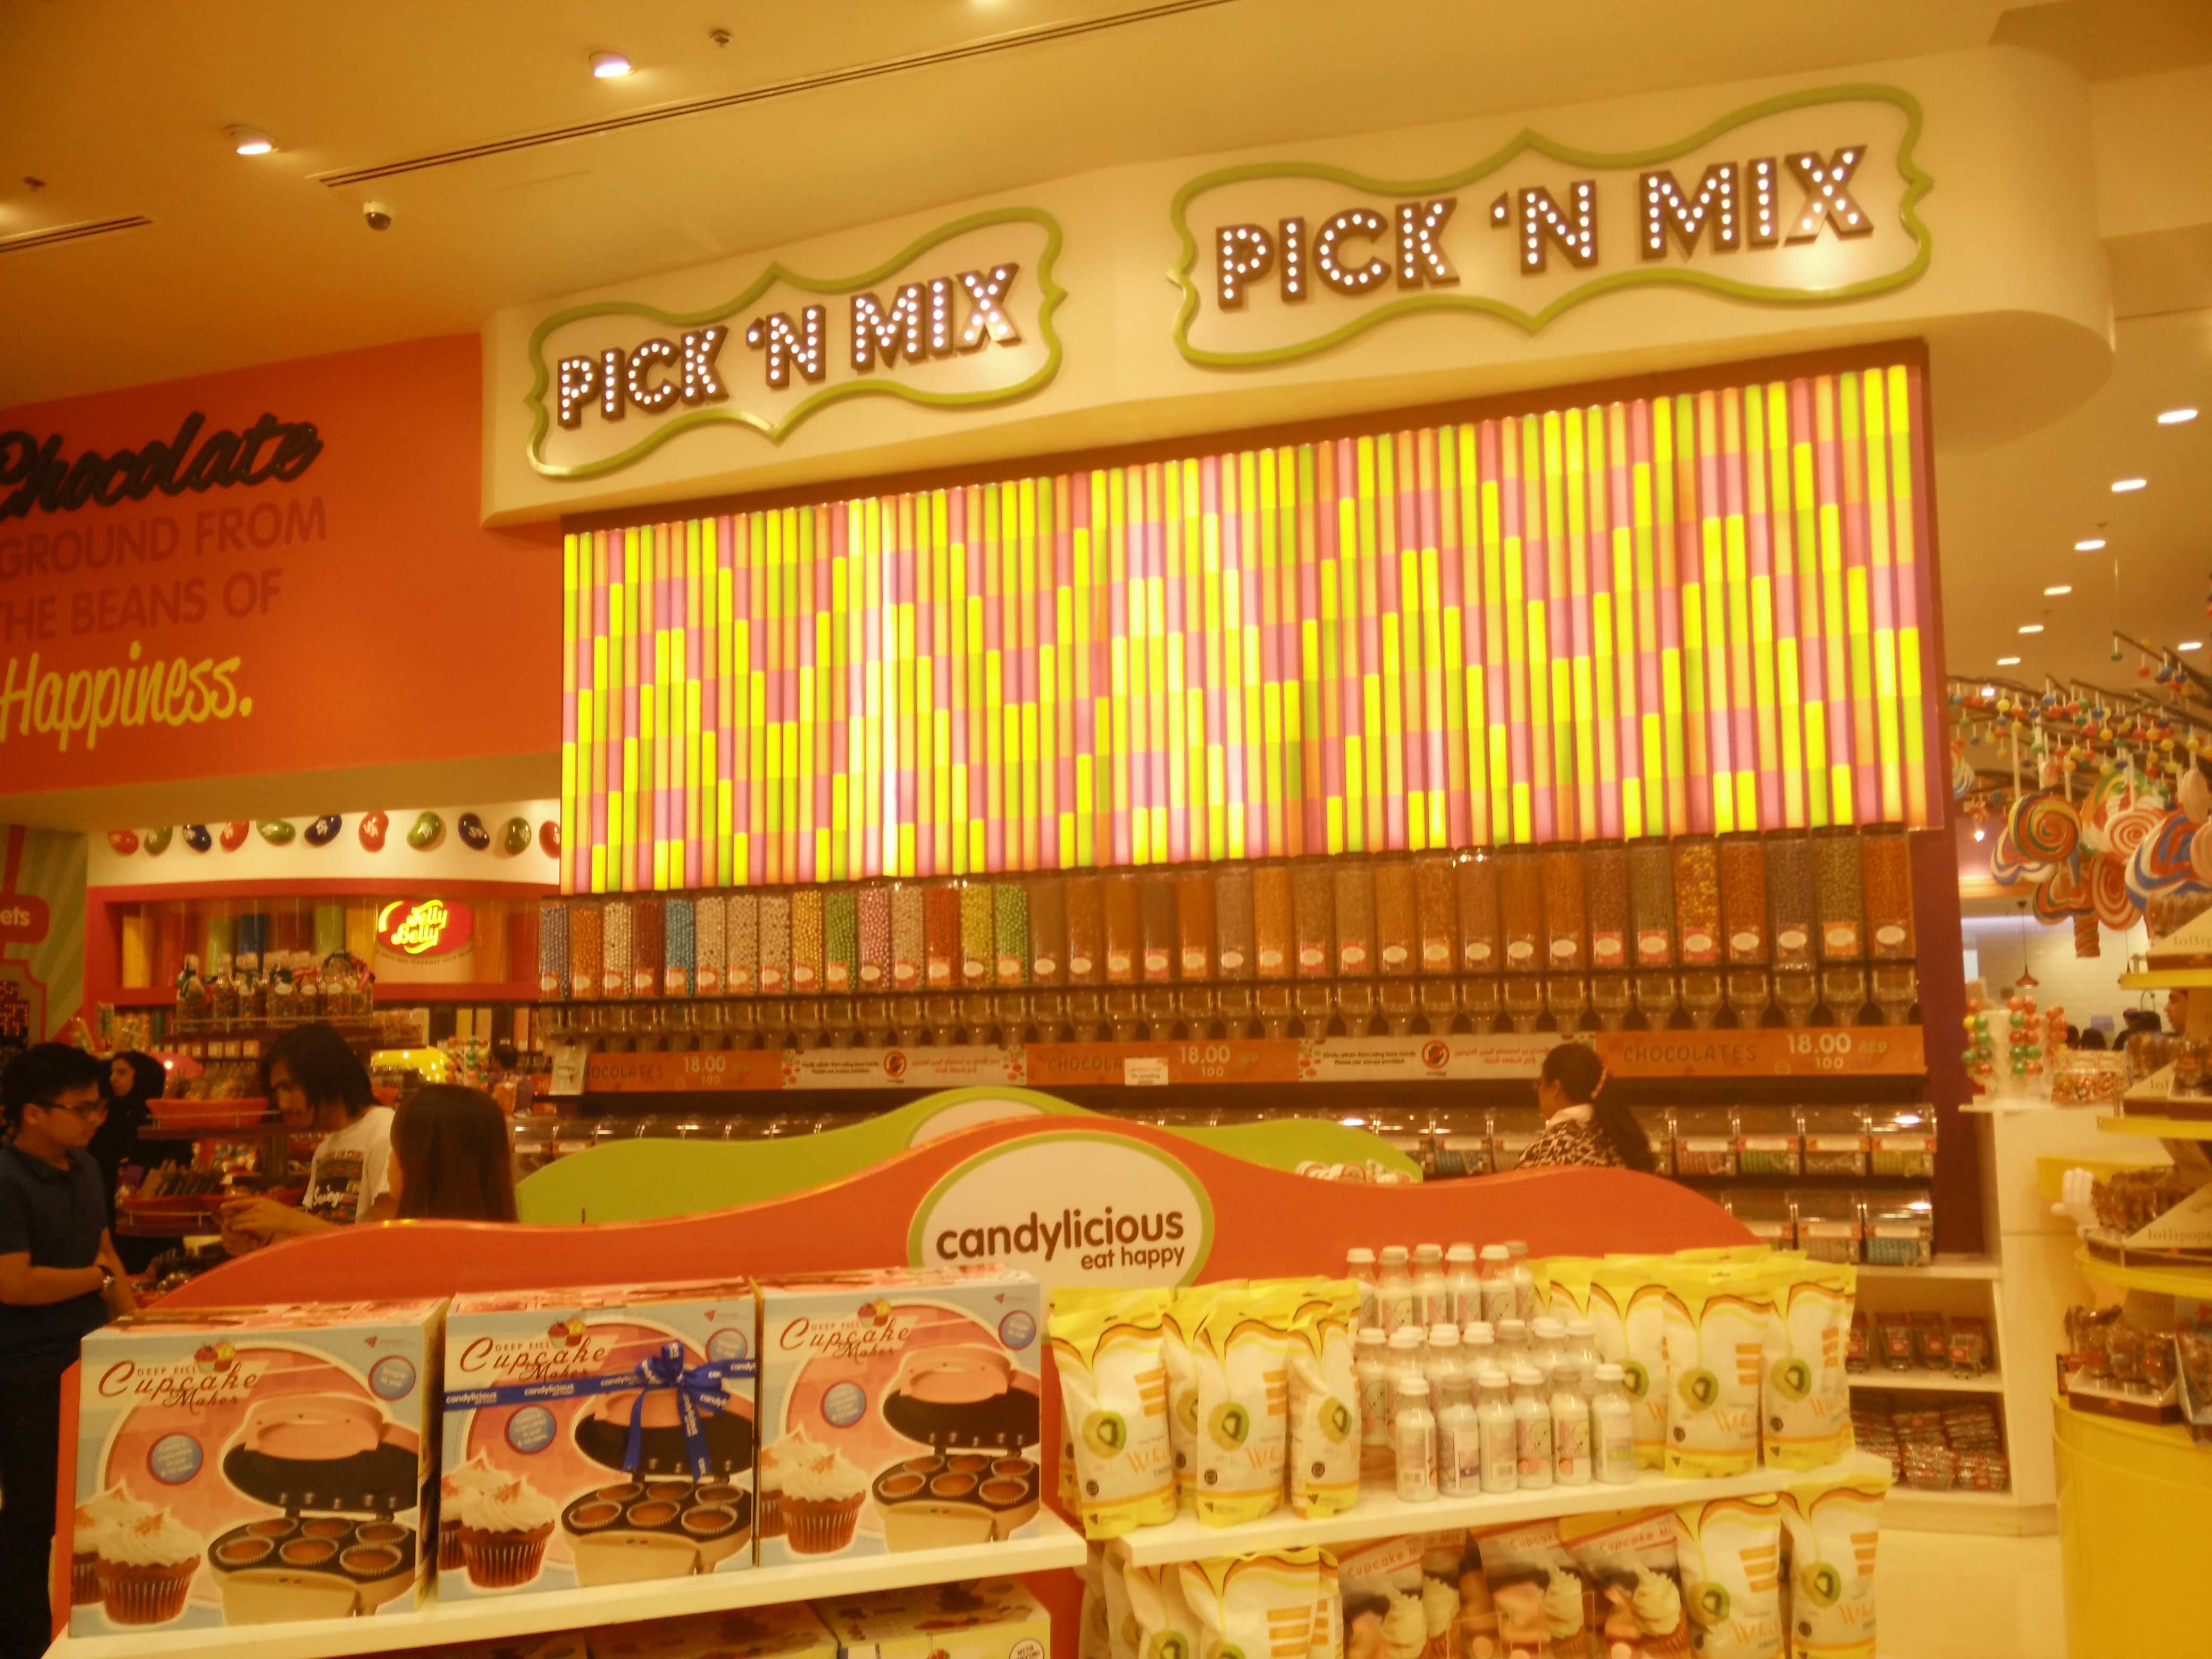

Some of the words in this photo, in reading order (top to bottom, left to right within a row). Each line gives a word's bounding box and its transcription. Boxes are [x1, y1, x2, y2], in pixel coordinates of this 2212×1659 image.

[1216, 197, 1461, 311] PICK
[1639, 145, 1874, 261] MIX
[557, 325, 729, 429] PICK
[851, 262, 1021, 372] MIX
[0, 516, 179, 581] GROUND
[195, 496, 327, 557] FROM
[70, 577, 209, 635] BEANS
[222, 568, 282, 618] OF
[0, 640, 253, 752] Happiness.
[406, 899, 448, 929] Jelly
[391, 923, 440, 954] Belly
[1049, 1056, 1124, 1071] CHOCOLA
[1179, 1045, 1230, 1064] 18.00
[1623, 1043, 1757, 1062] CHOCOLATES
[1786, 1033, 1851, 1055] 18.00
[683, 1056, 725, 1073] 18.00
[1202, 1066, 1224, 1078] 100
[1816, 1058, 1844, 1069] 100
[936, 1206, 1184, 1262] candylicious
[1081, 1249, 1115, 1270] eat
[1120, 1246, 1185, 1270] happy
[495, 1343, 523, 1352] DEEP
[780, 1317, 909, 1354] Cupcake
[460, 1337, 605, 1375] Cupcake
[833, 1340, 894, 1366] Maker
[98, 1360, 257, 1402] Cupcake
[137, 1367, 166, 1376] DEEP
[162, 1388, 239, 1415] Maker
[1600, 1532, 1654, 1555] Cupcake
[1659, 1526, 1672, 1538] Mi
[1348, 1552, 1404, 1579] Cupcake
[1409, 1544, 1421, 1557] Mi
